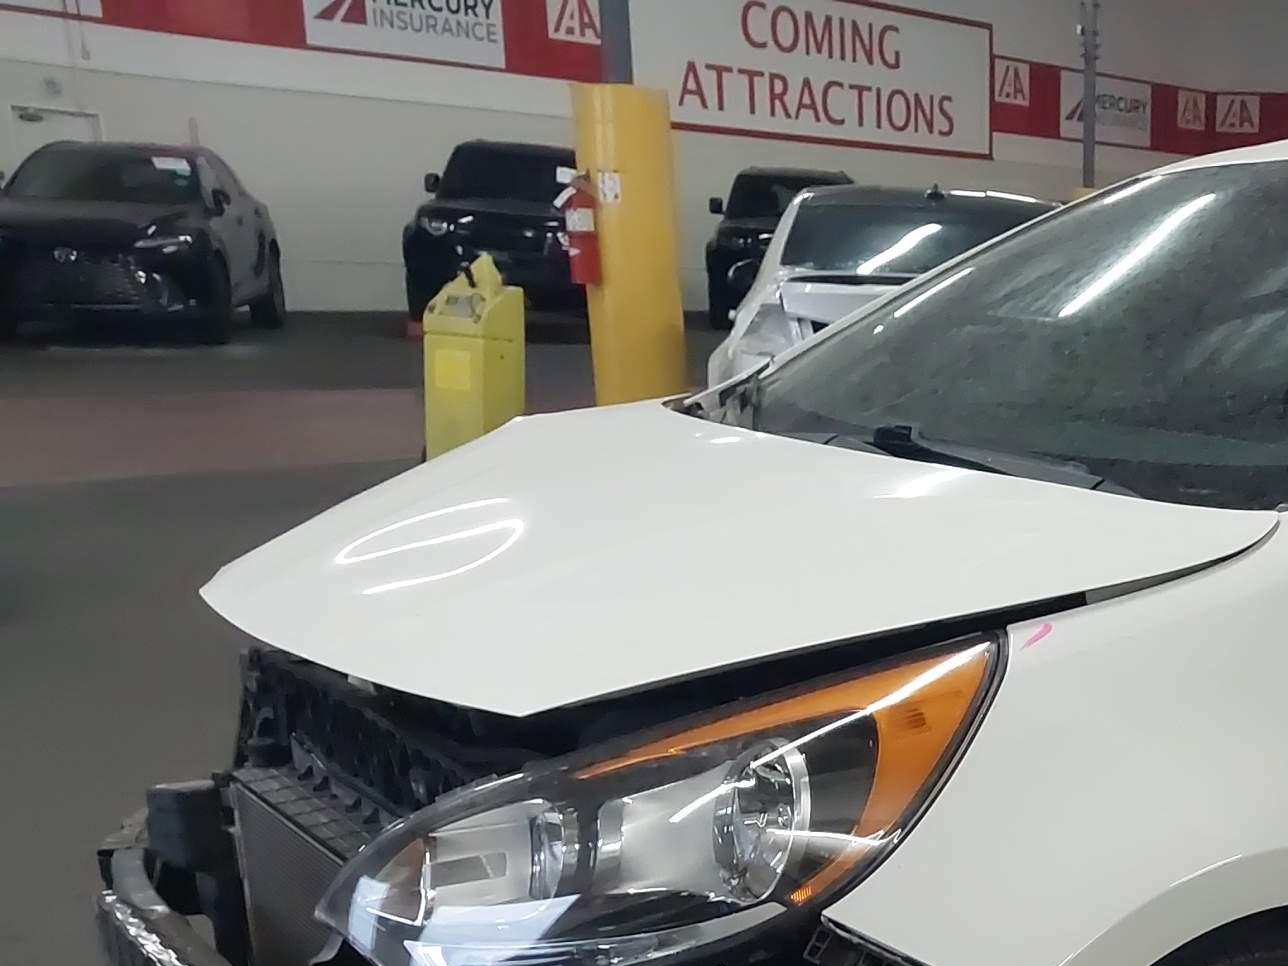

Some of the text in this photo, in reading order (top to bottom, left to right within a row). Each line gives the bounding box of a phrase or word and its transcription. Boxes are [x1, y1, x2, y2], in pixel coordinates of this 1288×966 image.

[373, 8, 498, 43] INSURANCE
[740, 0, 901, 70] COMING
[678, 60, 955, 137] ATTRACTIONS
